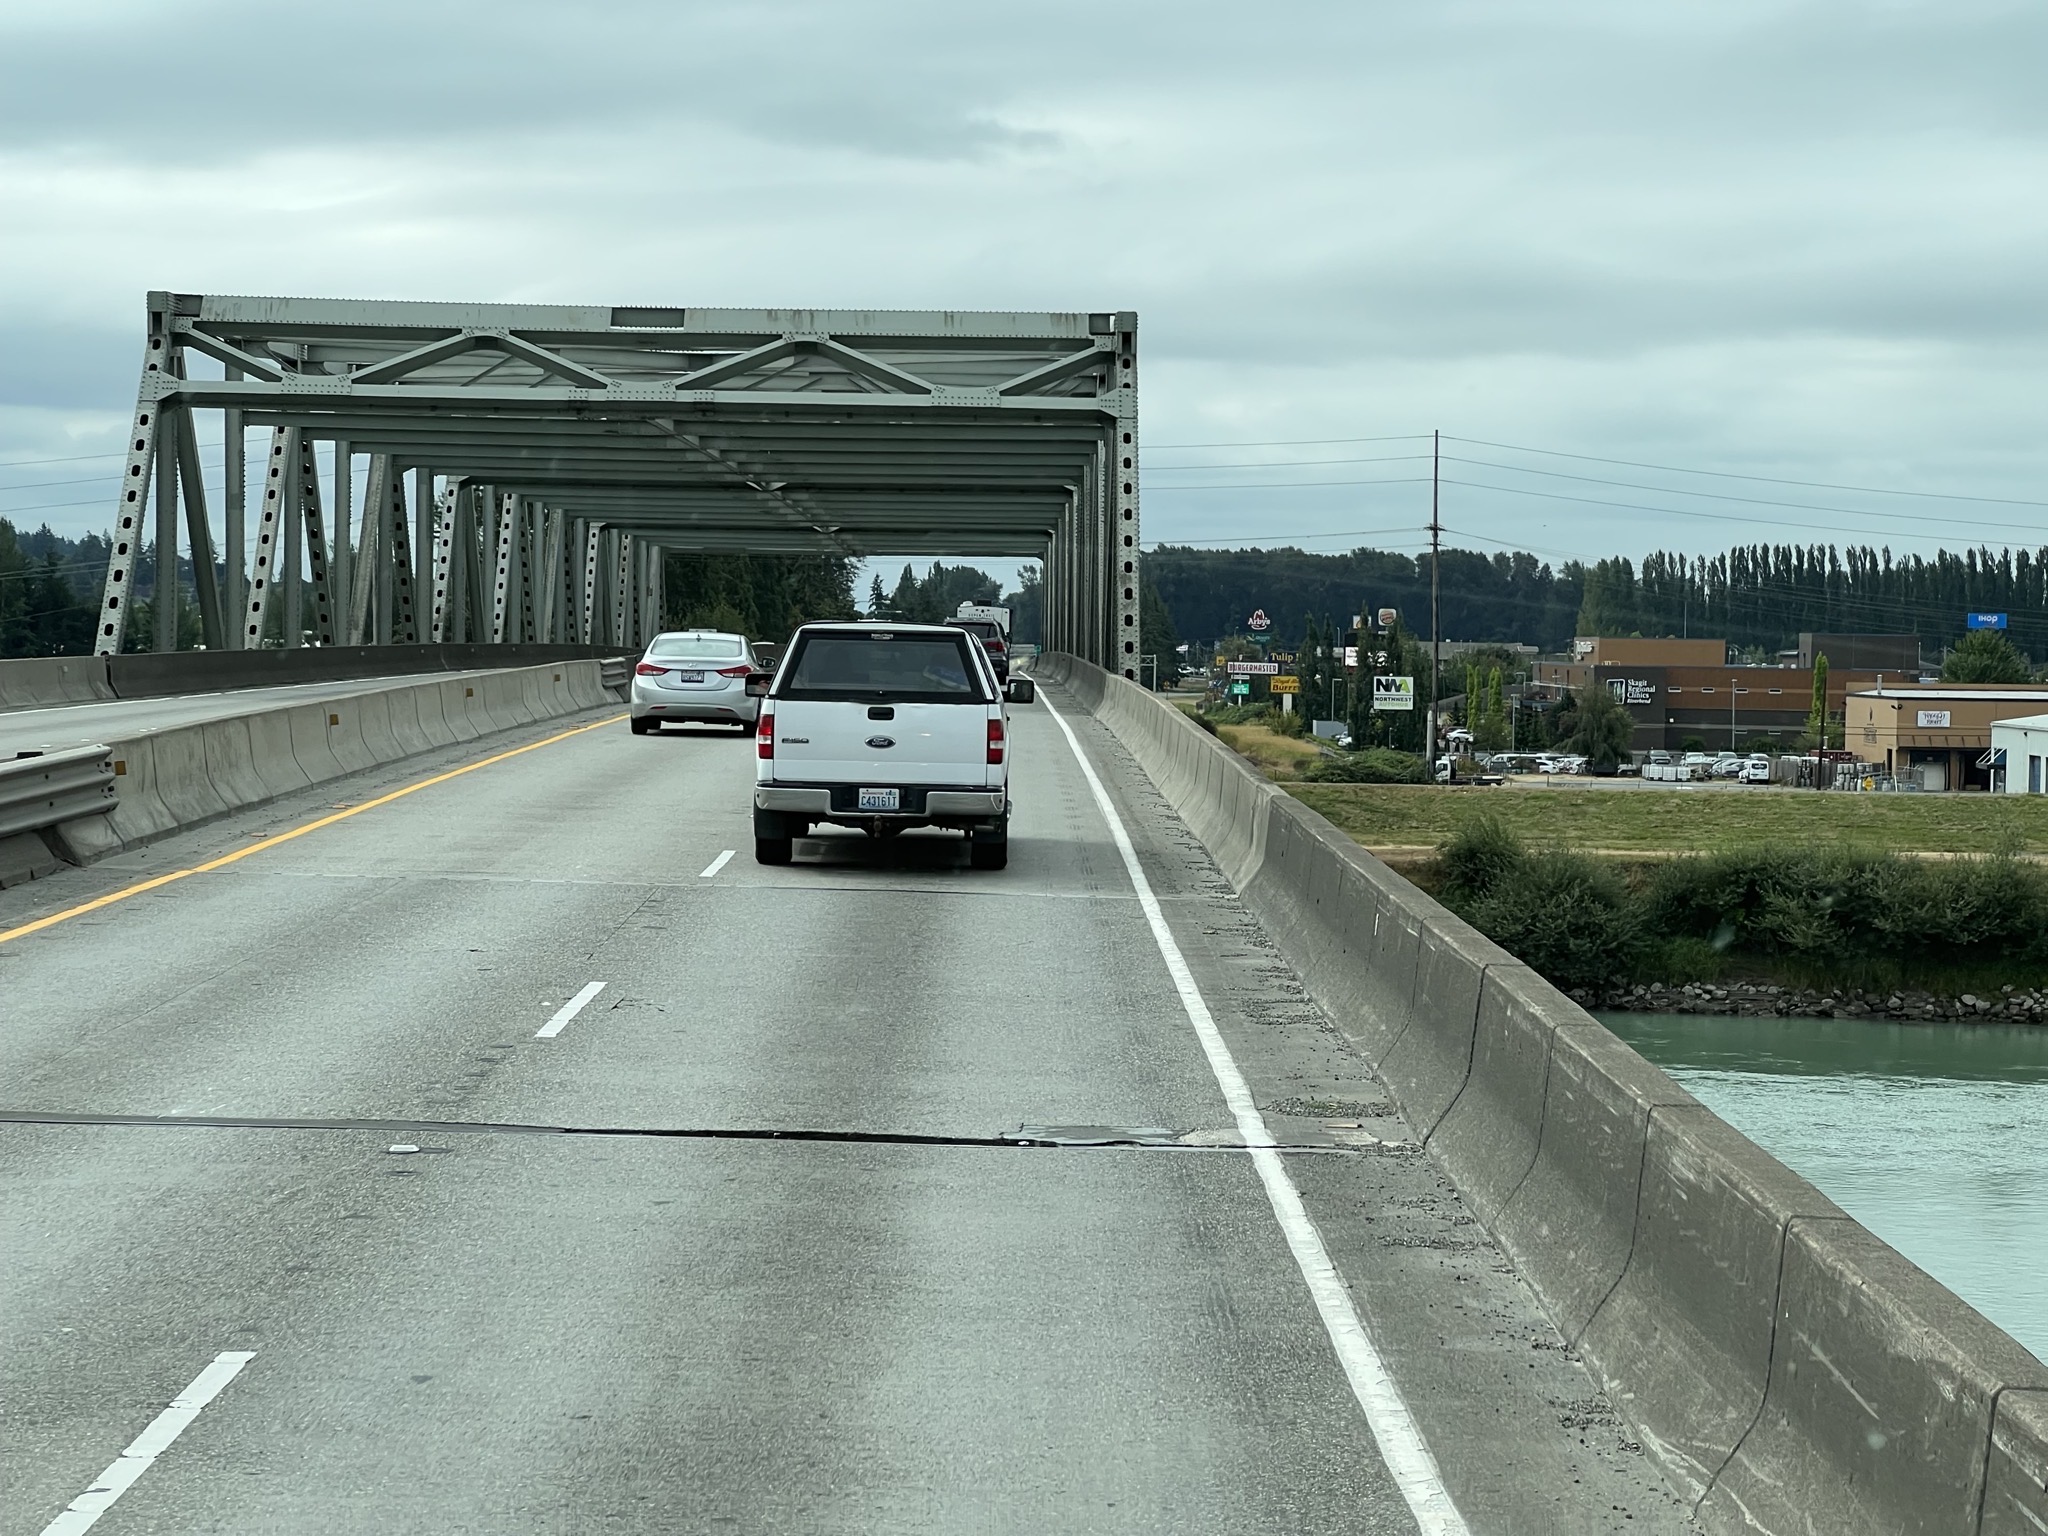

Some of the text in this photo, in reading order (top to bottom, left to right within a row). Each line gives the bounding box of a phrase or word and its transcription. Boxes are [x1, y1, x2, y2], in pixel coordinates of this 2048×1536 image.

[1248, 617, 1271, 626] Arby's
[1270, 652, 1294, 664] Tulip
[1228, 663, 1277, 673] BURGERMASTER
[1627, 679, 1648, 688] Skagit
[1627, 685, 1656, 693] Regional
[871, 737, 889, 746] Ford
[861, 796, 898, 807] C43161T
